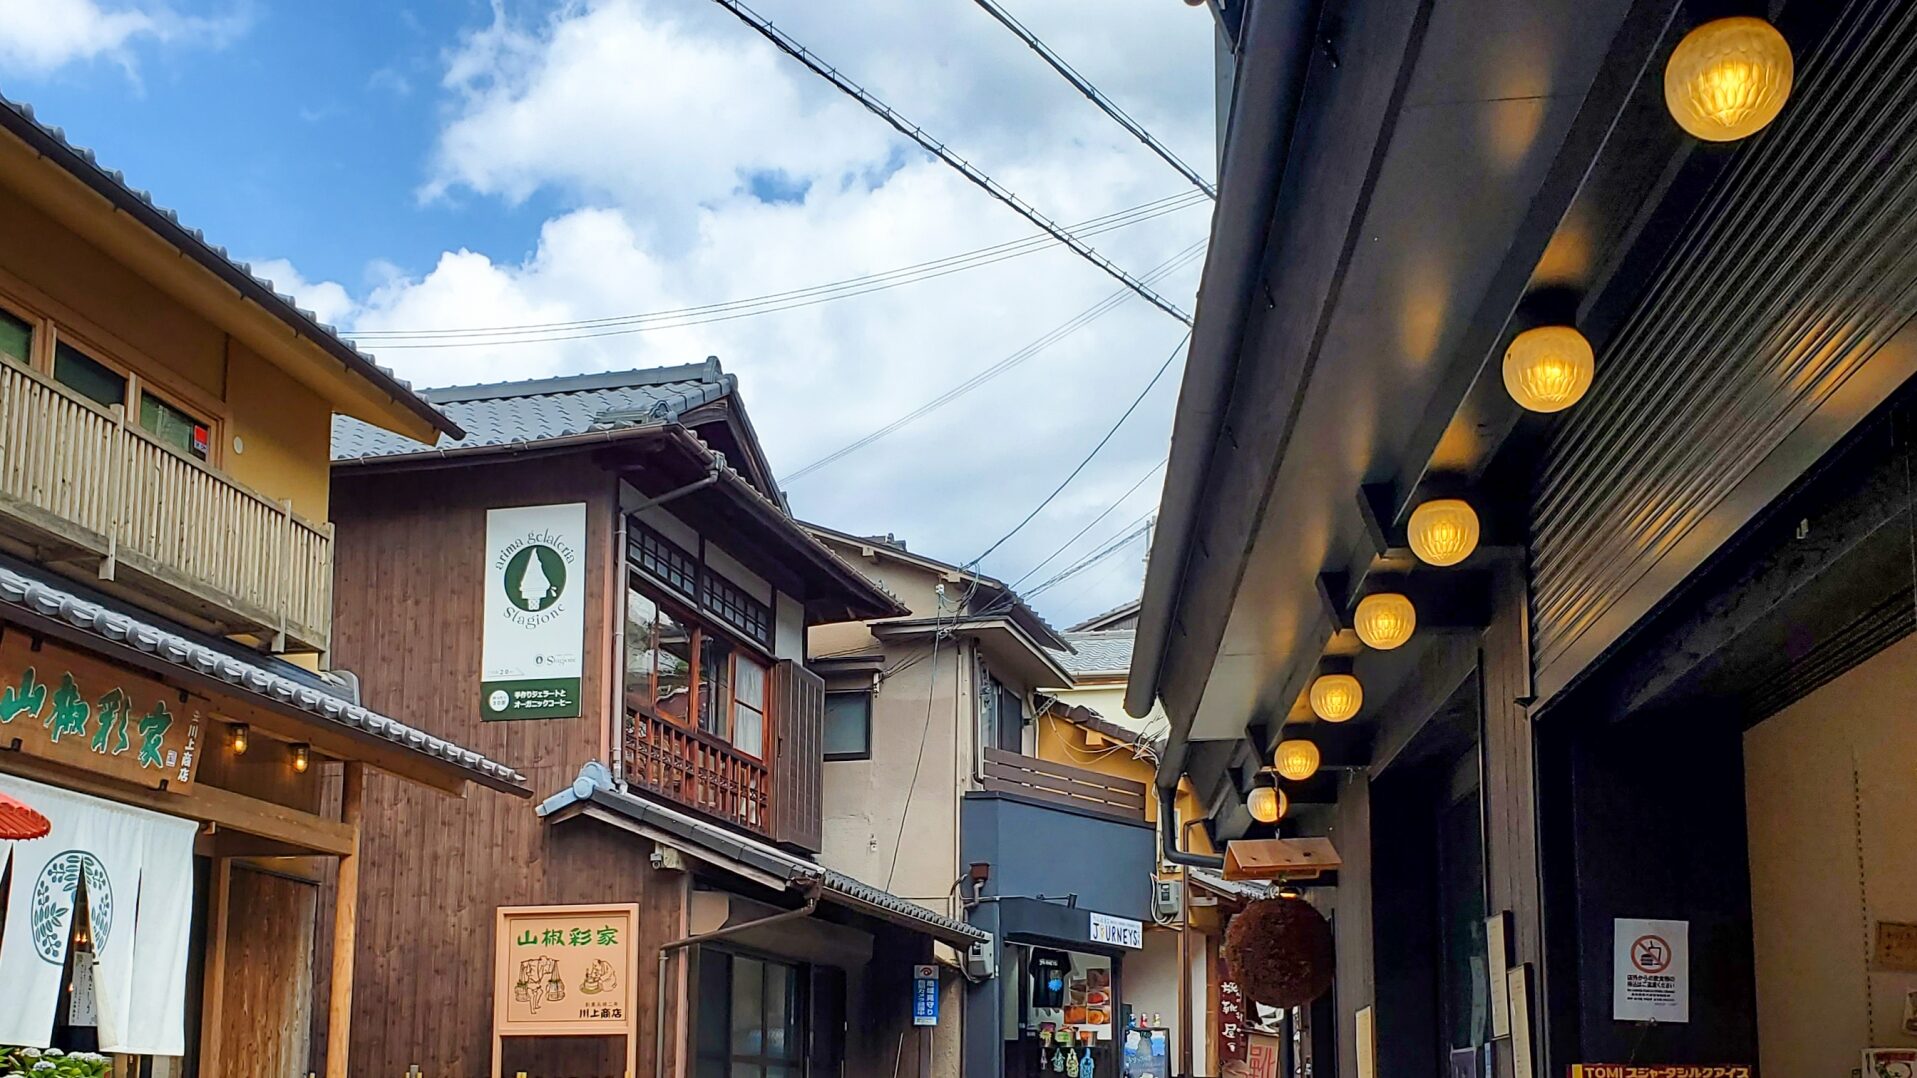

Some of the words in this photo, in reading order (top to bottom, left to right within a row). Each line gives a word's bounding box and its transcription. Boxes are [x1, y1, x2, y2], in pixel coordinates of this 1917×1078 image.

[495, 538, 523, 570] arima
[527, 528, 575, 565] gelateria
[503, 603, 566, 630] Stagione
[514, 690, 567, 699] 手作りジェラートと
[514, 700, 572, 709] オーガニックコーヒー
[0, 666, 174, 769] 山椒彩家
[177, 724, 199, 783] 川上商店
[517, 925, 618, 947] 山椒彩家
[579, 1008, 622, 1019] 川上商店
[1626, 1067, 1749, 1078] スジャータシルクアイス
